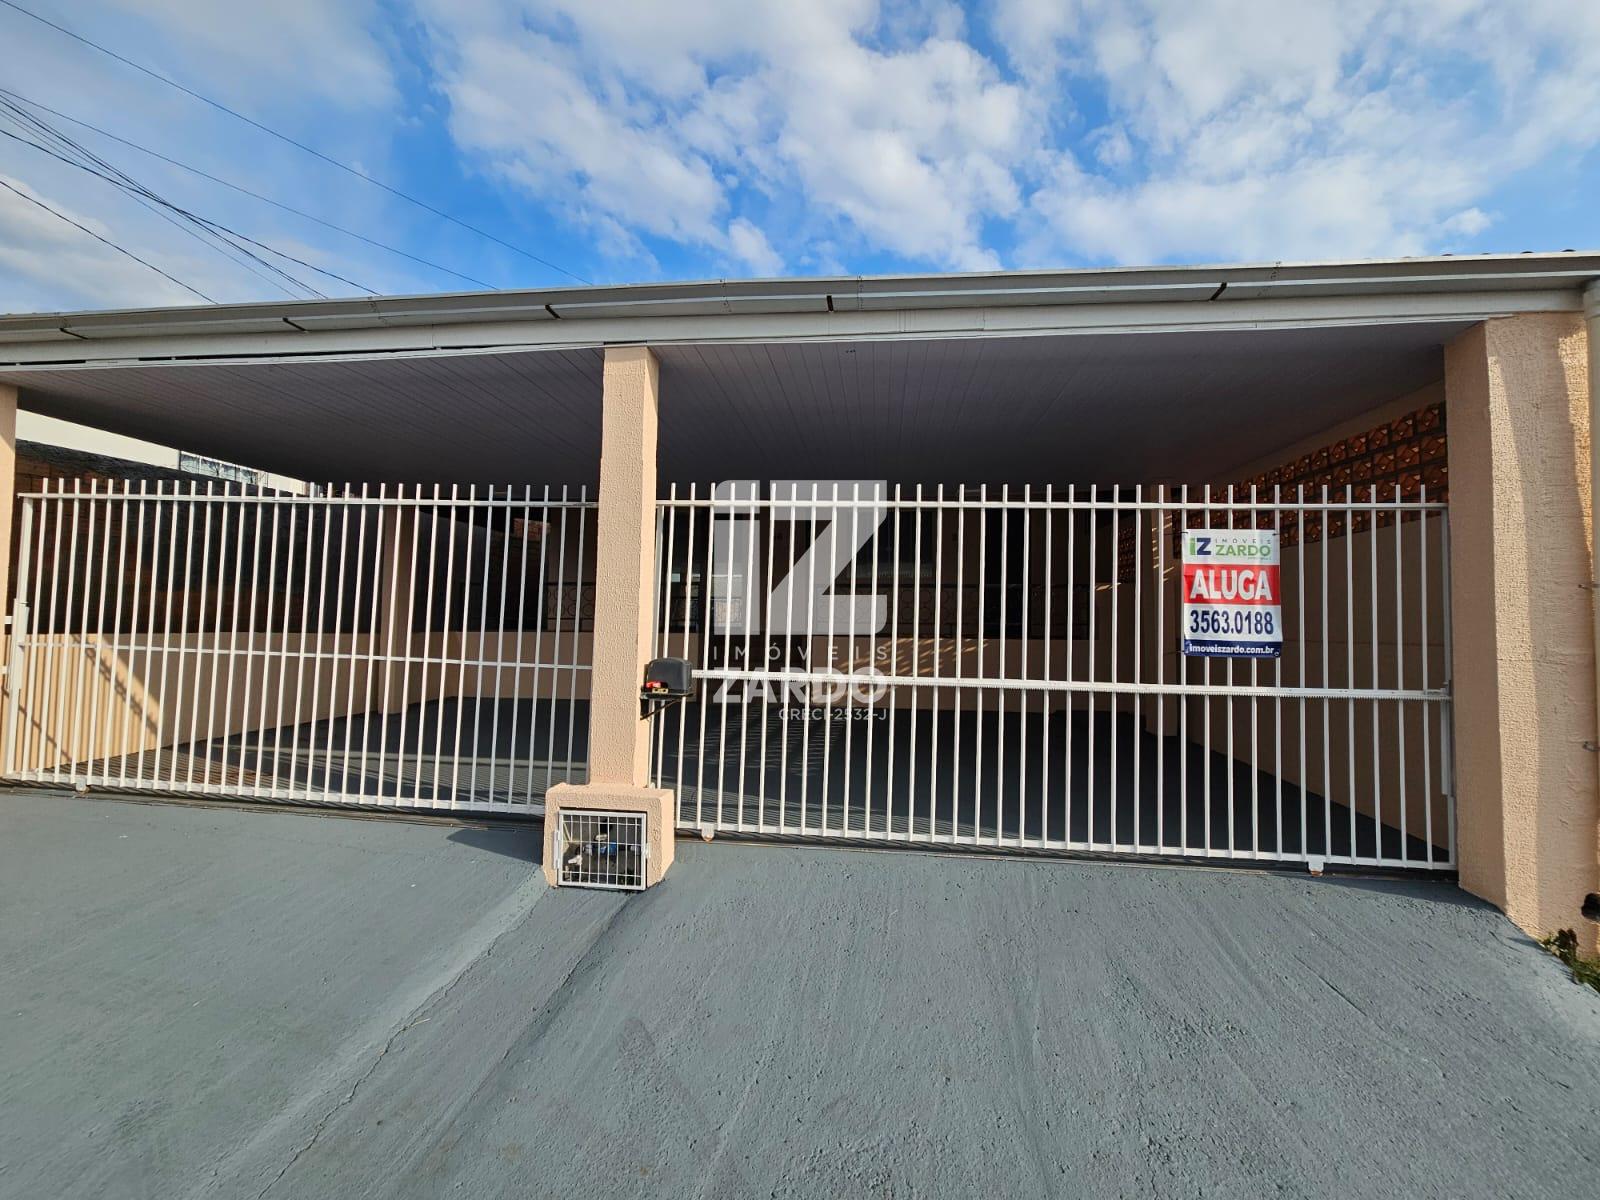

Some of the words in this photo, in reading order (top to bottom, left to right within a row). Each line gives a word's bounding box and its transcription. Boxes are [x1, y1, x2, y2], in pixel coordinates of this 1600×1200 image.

[1215, 545, 1271, 556] ZARDO
[1190, 569, 1272, 600] ALUGA
[1190, 610, 1274, 635] 3563.0188
[1189, 643, 1274, 654] imoveiszardo.com.br
